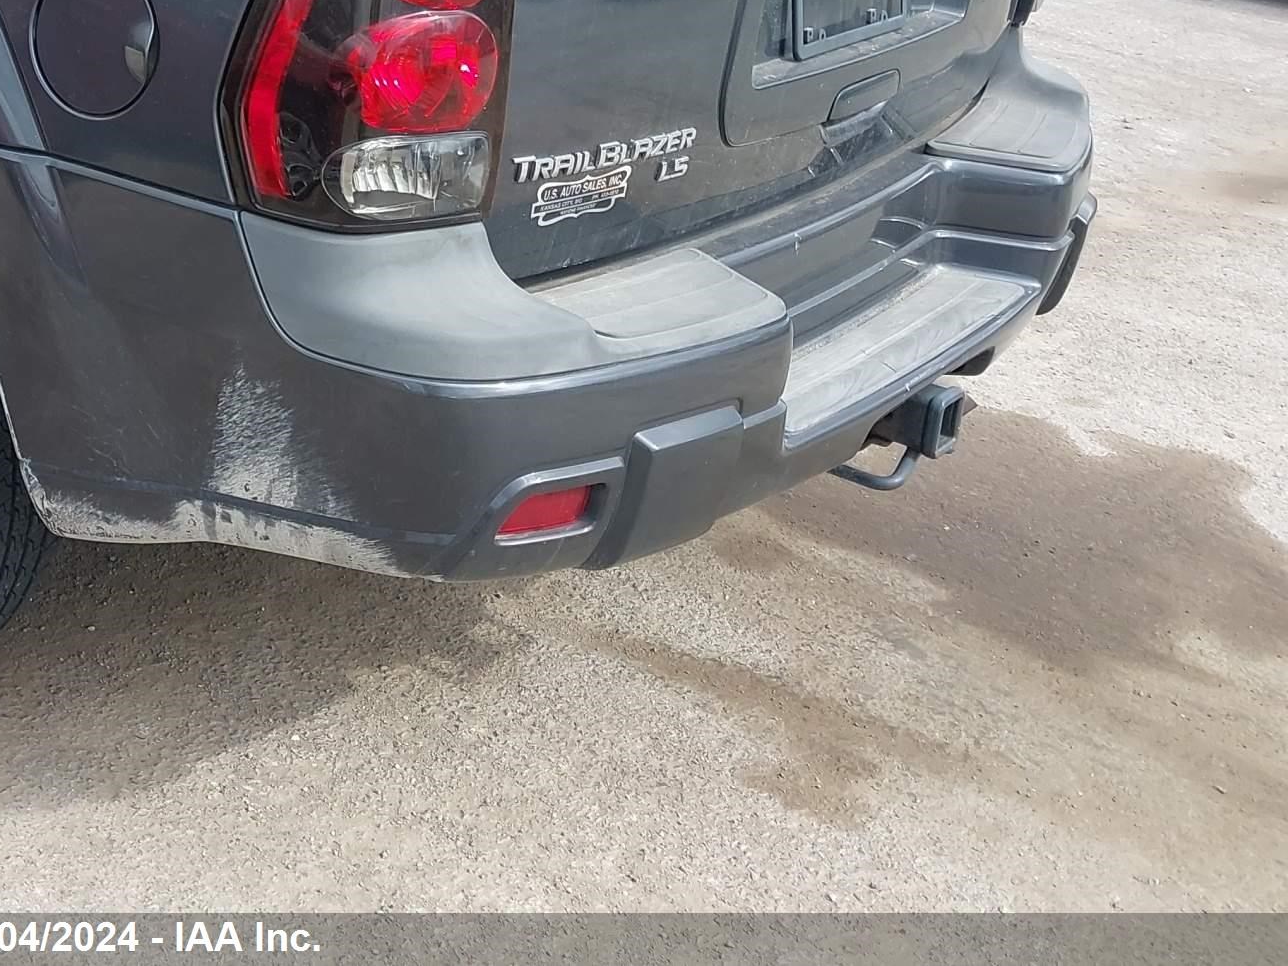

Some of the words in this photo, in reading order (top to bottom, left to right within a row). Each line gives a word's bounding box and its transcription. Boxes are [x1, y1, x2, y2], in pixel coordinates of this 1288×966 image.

[655, 155, 690, 183] LS
[543, 188, 558, 201] U.S.
[560, 184, 582, 197] AUTO
